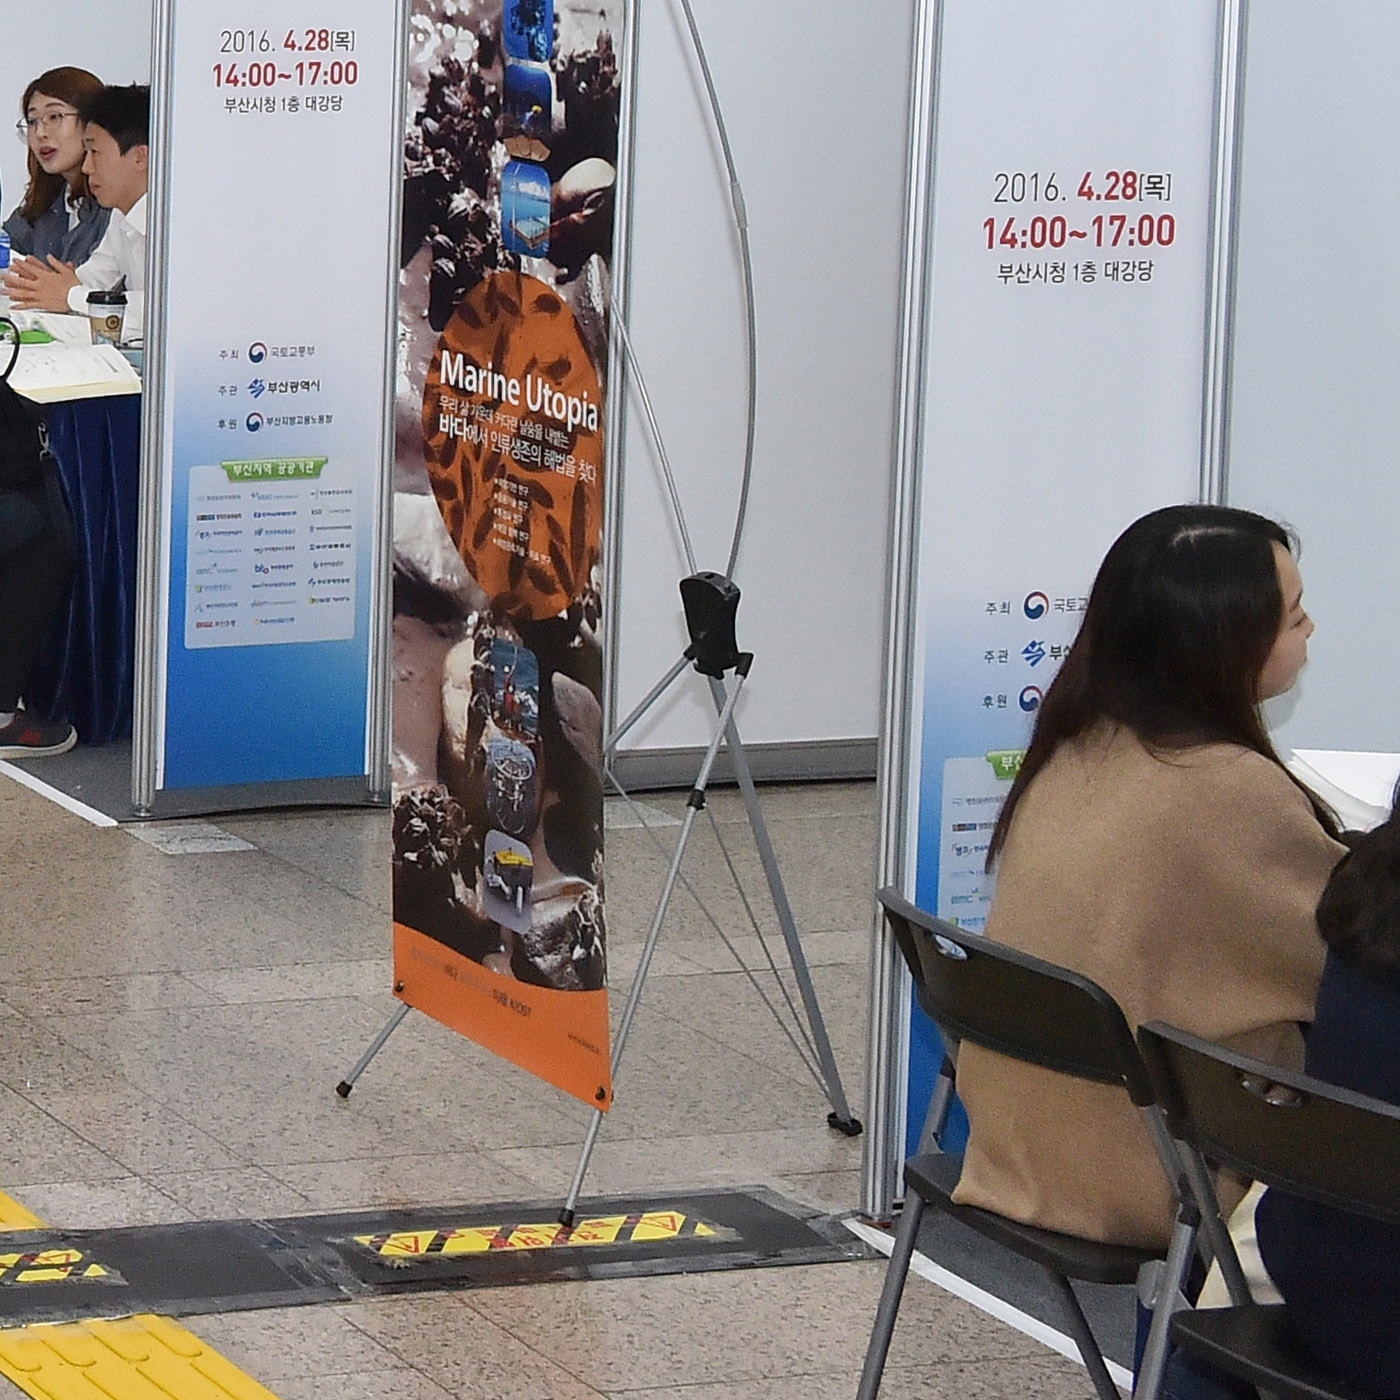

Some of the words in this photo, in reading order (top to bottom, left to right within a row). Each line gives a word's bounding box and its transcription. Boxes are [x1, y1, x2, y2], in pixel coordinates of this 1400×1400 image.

[220, 30, 276, 52] 2016.
[283, 29, 356, 51] 4.28[목]
[212, 61, 358, 87] 14:00~17:00
[224, 96, 276, 114] 부산시청
[281, 97, 300, 113] 1층
[305, 95, 344, 112] 대강당
[993, 172, 1067, 202] 2016.
[1076, 170, 1172, 202] 4.28[목]
[982, 214, 1175, 250] 14:00~17:00
[997, 262, 1066, 284] 부산시청
[1072, 261, 1096, 283] 1층
[1104, 259, 1154, 282] 대강당
[270, 346, 316, 358] 국토교통부
[267, 379, 322, 394] 부산광역시
[439, 349, 521, 405] Marine
[526, 373, 599, 432] Utopia
[438, 413, 489, 448] 바다에서
